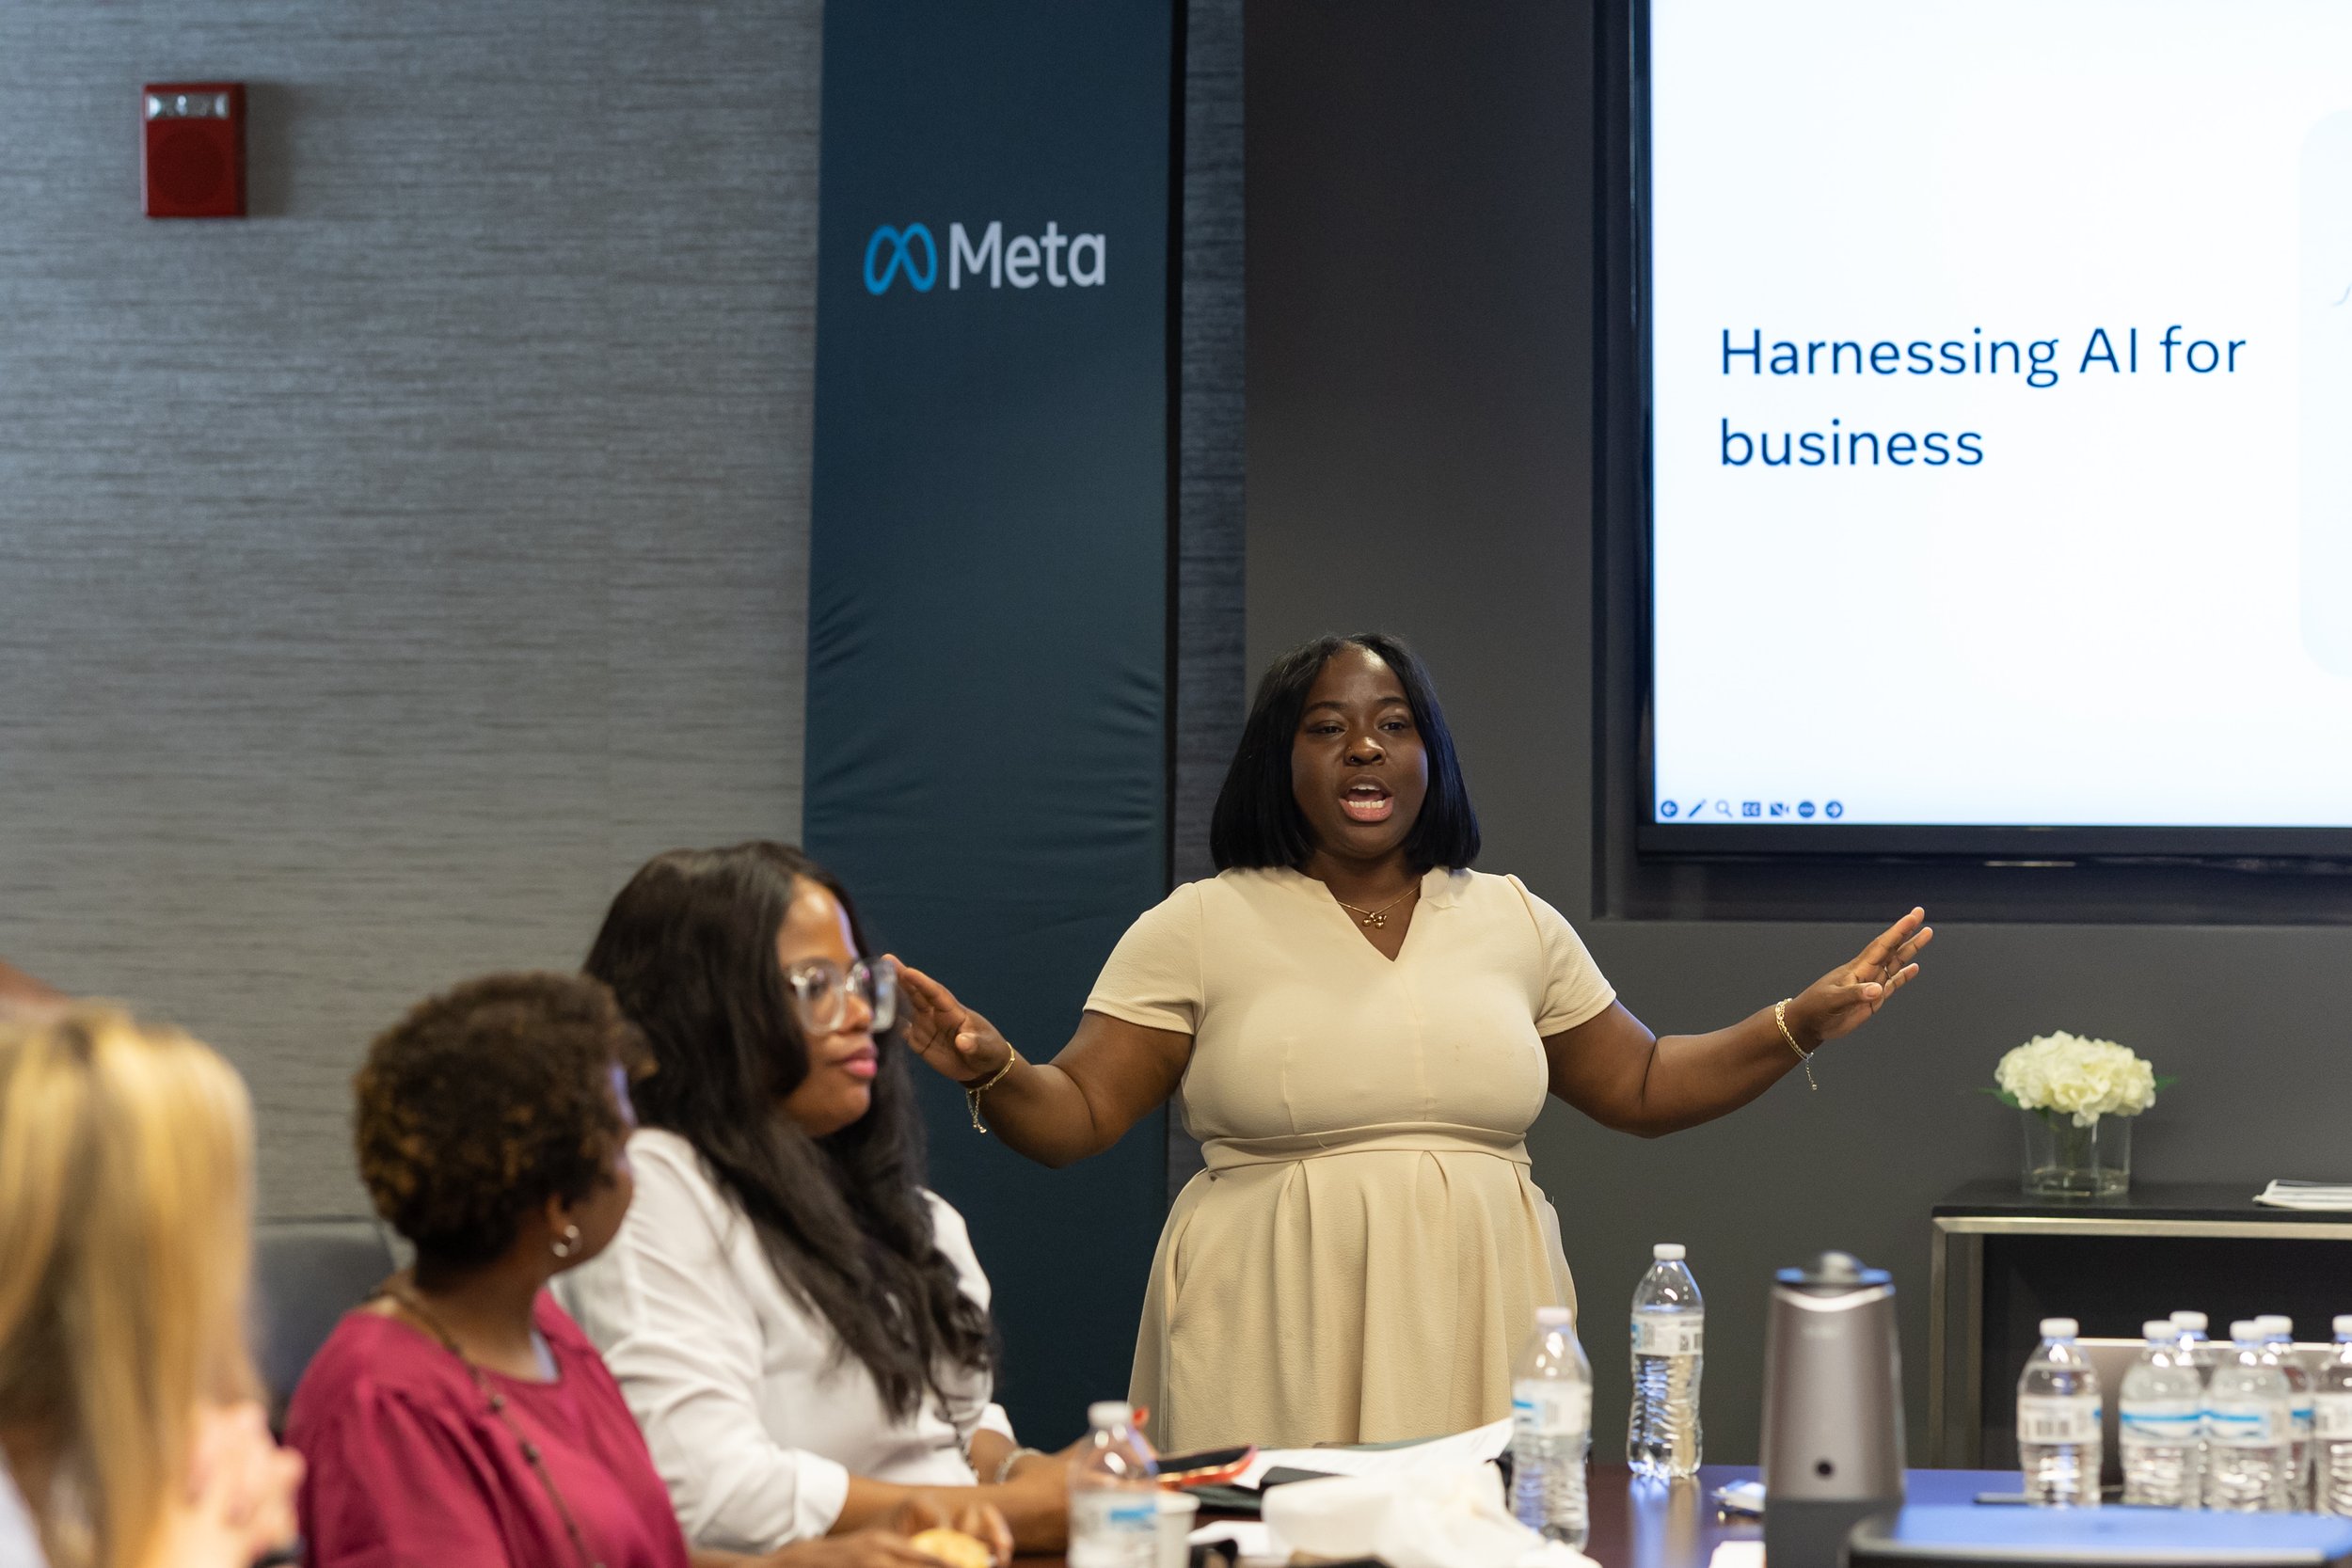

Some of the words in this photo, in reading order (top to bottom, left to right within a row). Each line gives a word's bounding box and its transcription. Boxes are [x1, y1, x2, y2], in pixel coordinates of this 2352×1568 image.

[949, 221, 1106, 290] Meta
[1721, 326, 2060, 389] Harnessing
[2078, 326, 2138, 374] AI
[2158, 324, 2248, 374] for
[1720, 417, 1985, 467] business
